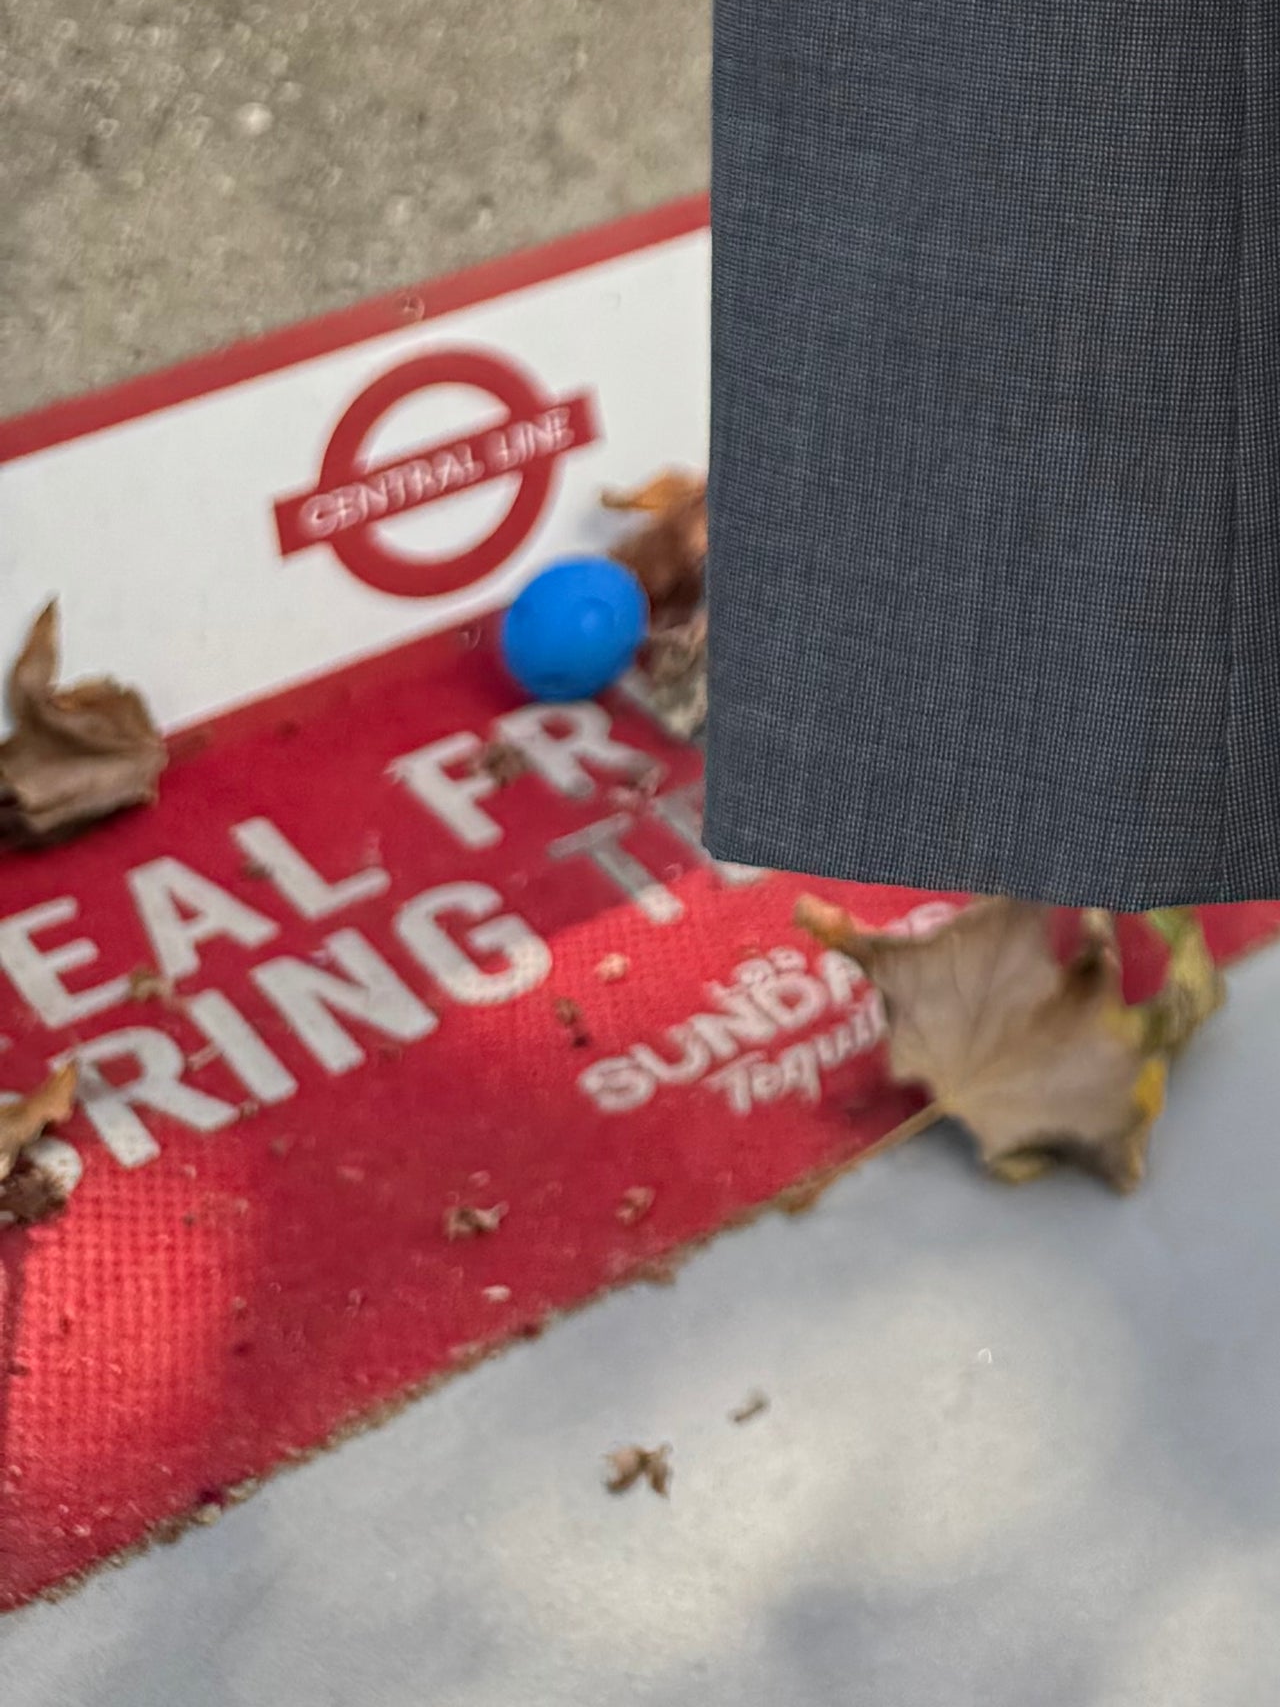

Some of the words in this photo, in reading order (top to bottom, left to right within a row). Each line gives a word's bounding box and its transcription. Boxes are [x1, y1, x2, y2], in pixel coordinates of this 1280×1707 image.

[300, 442, 485, 537] CENTRAL
[486, 405, 575, 473] LINE
[0, 816, 392, 1032] EAL
